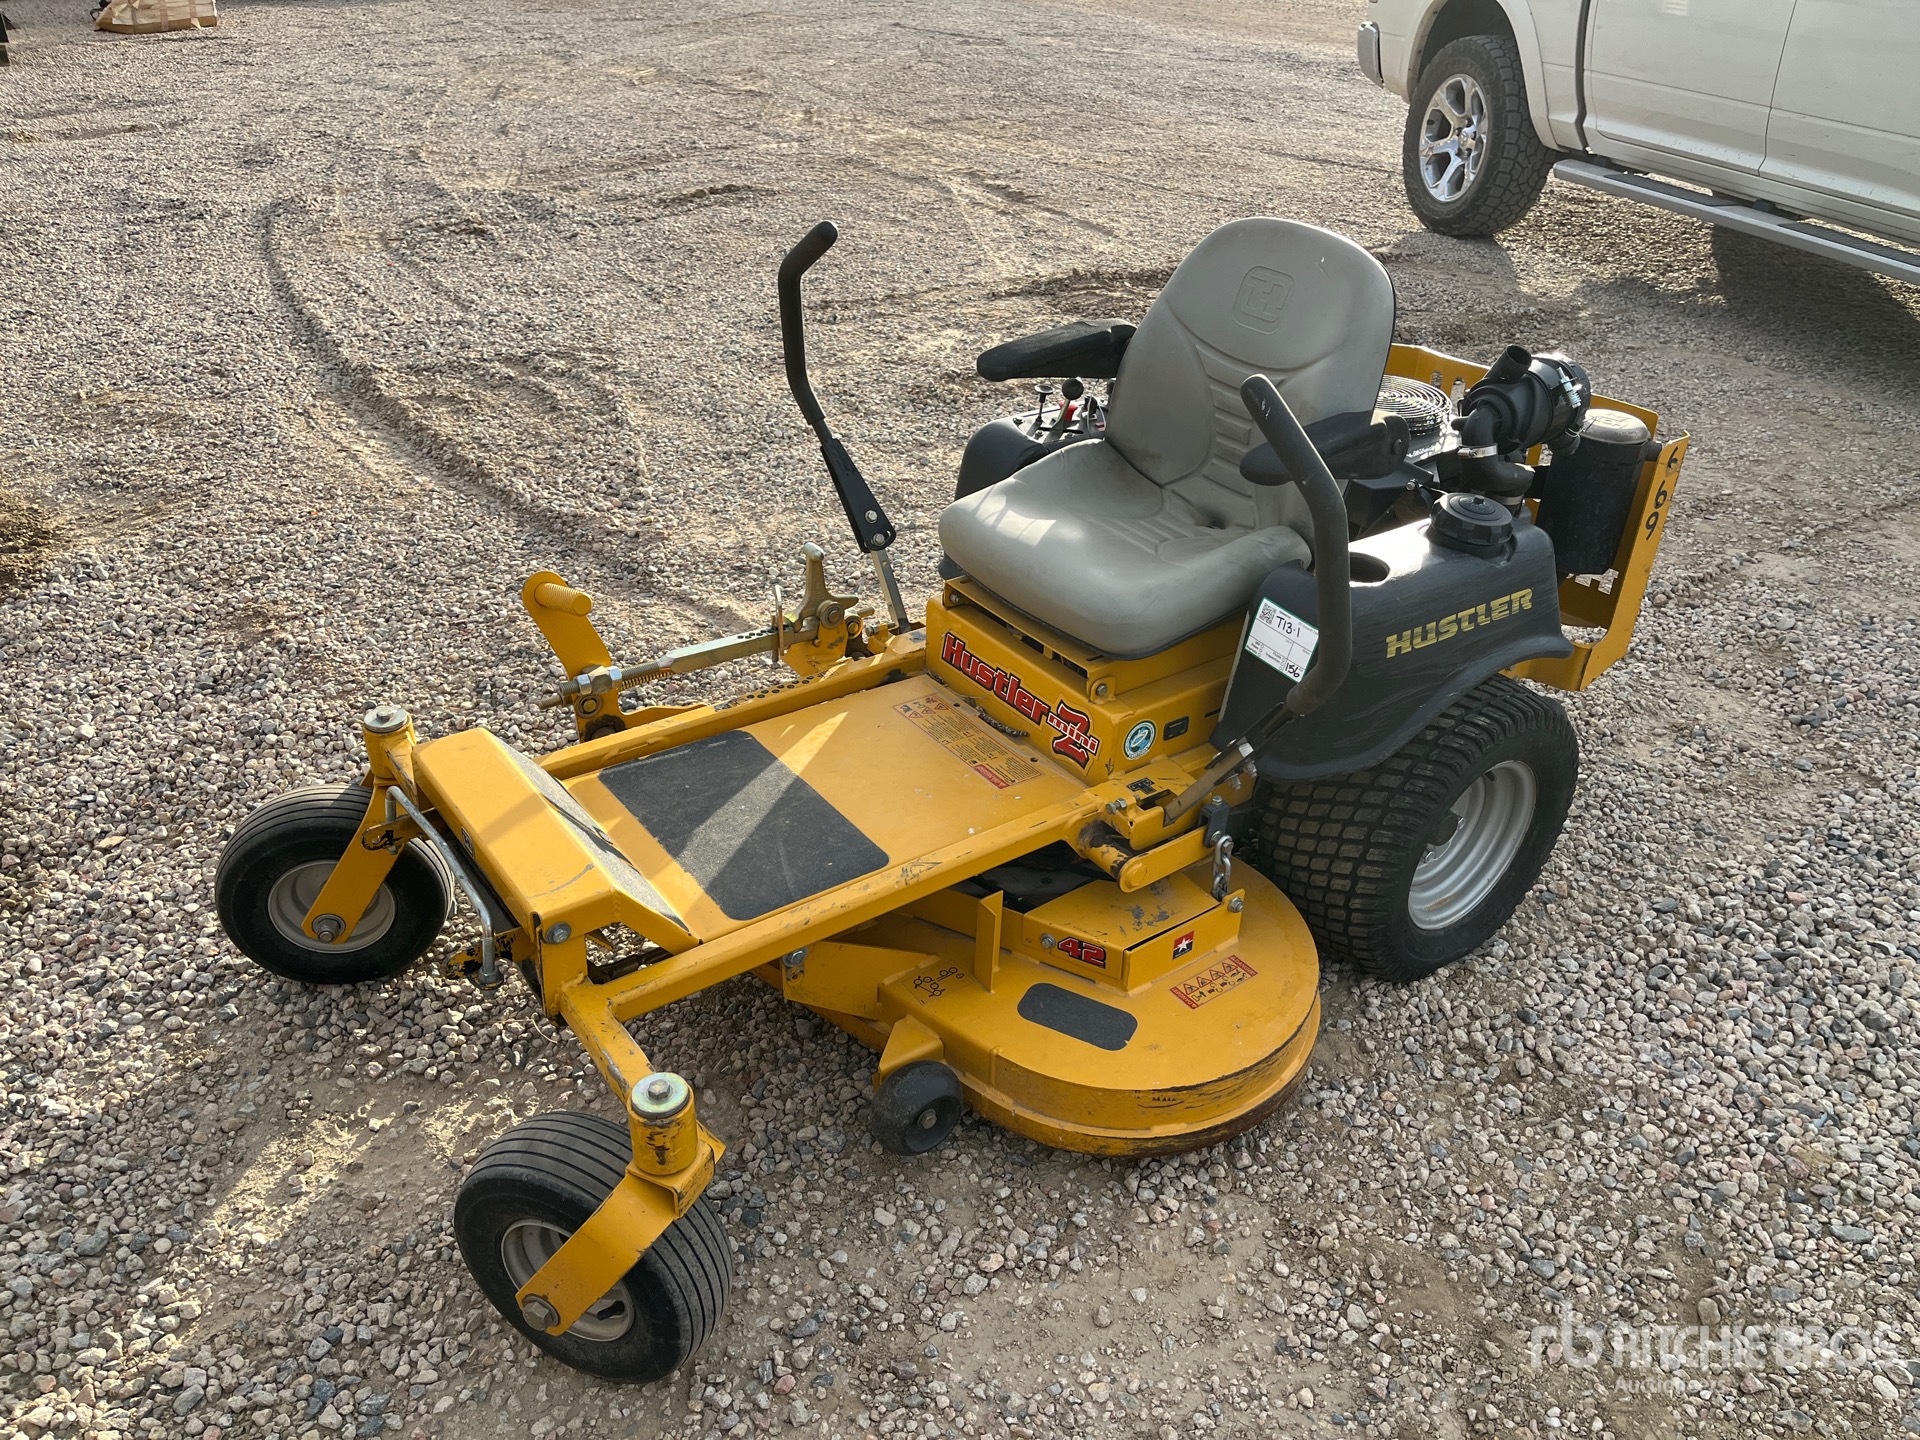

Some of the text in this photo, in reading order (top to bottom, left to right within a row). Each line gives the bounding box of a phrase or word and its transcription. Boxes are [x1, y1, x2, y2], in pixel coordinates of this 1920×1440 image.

[1385, 587, 1533, 658] HUSTLER
[942, 631, 1051, 726] Hustler
[1285, 661, 1300, 678] 156
[1057, 936, 1107, 969] 42
